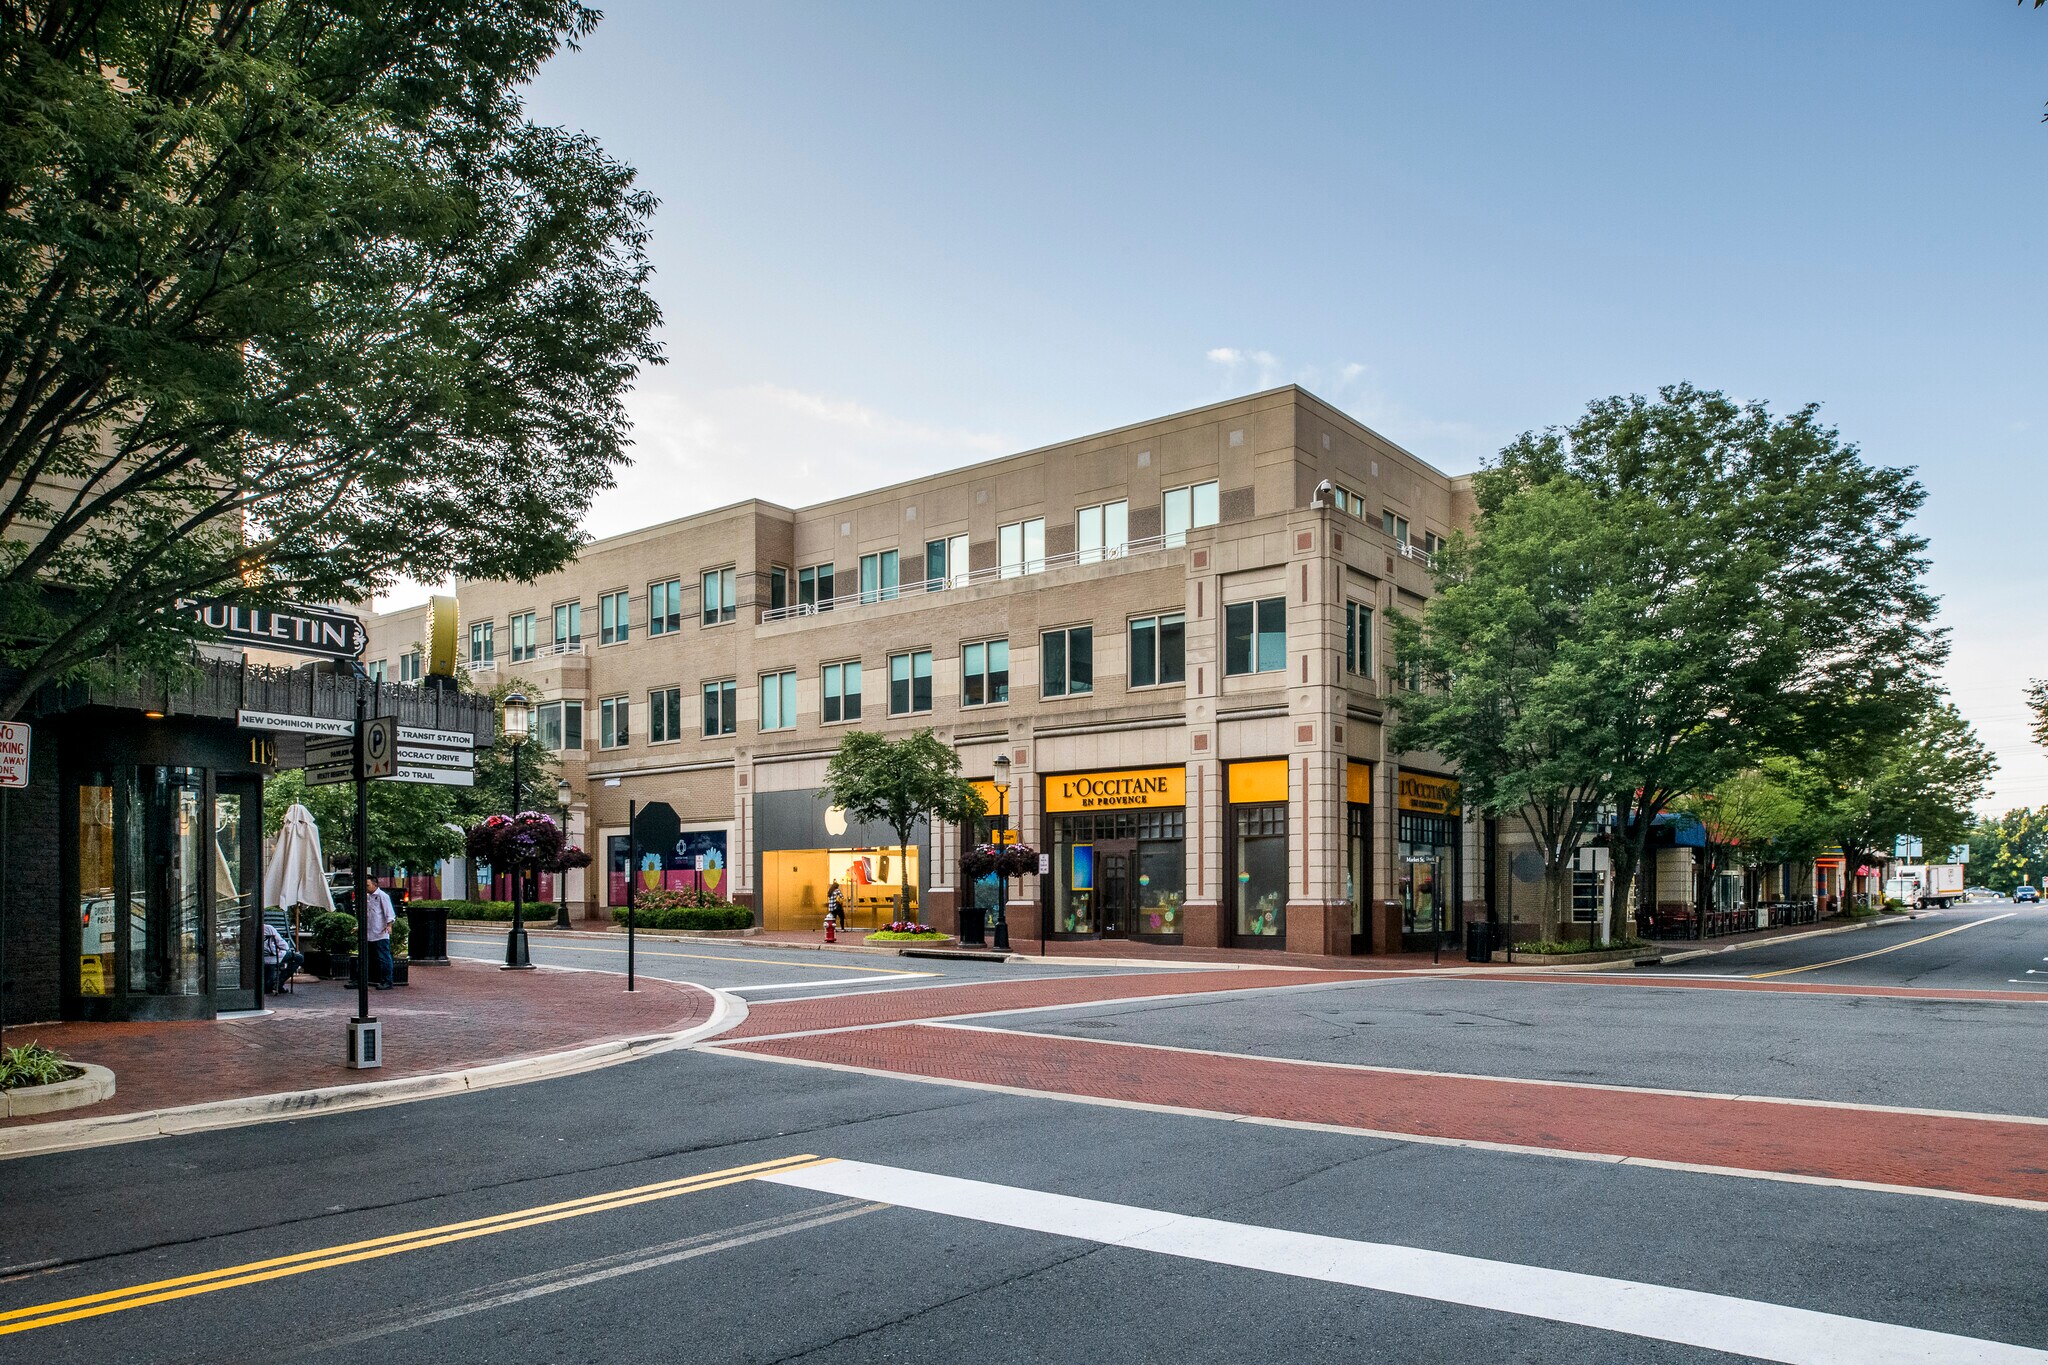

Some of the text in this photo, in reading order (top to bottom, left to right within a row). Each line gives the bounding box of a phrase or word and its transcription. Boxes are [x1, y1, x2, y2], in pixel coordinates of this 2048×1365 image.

[242, 715, 341, 731] NEW DOMINION PKWY
[372, 730, 383, 753] P
[402, 731, 435, 740] TRANSIT
[437, 734, 470, 744] STATION
[3, 757, 26, 766] AWAY
[436, 754, 460, 762] DRIVE
[412, 771, 435, 779] TRAIL
[1063, 776, 1167, 798] L'OCCITANE
[1082, 795, 1147, 806] EN PROVENCE
